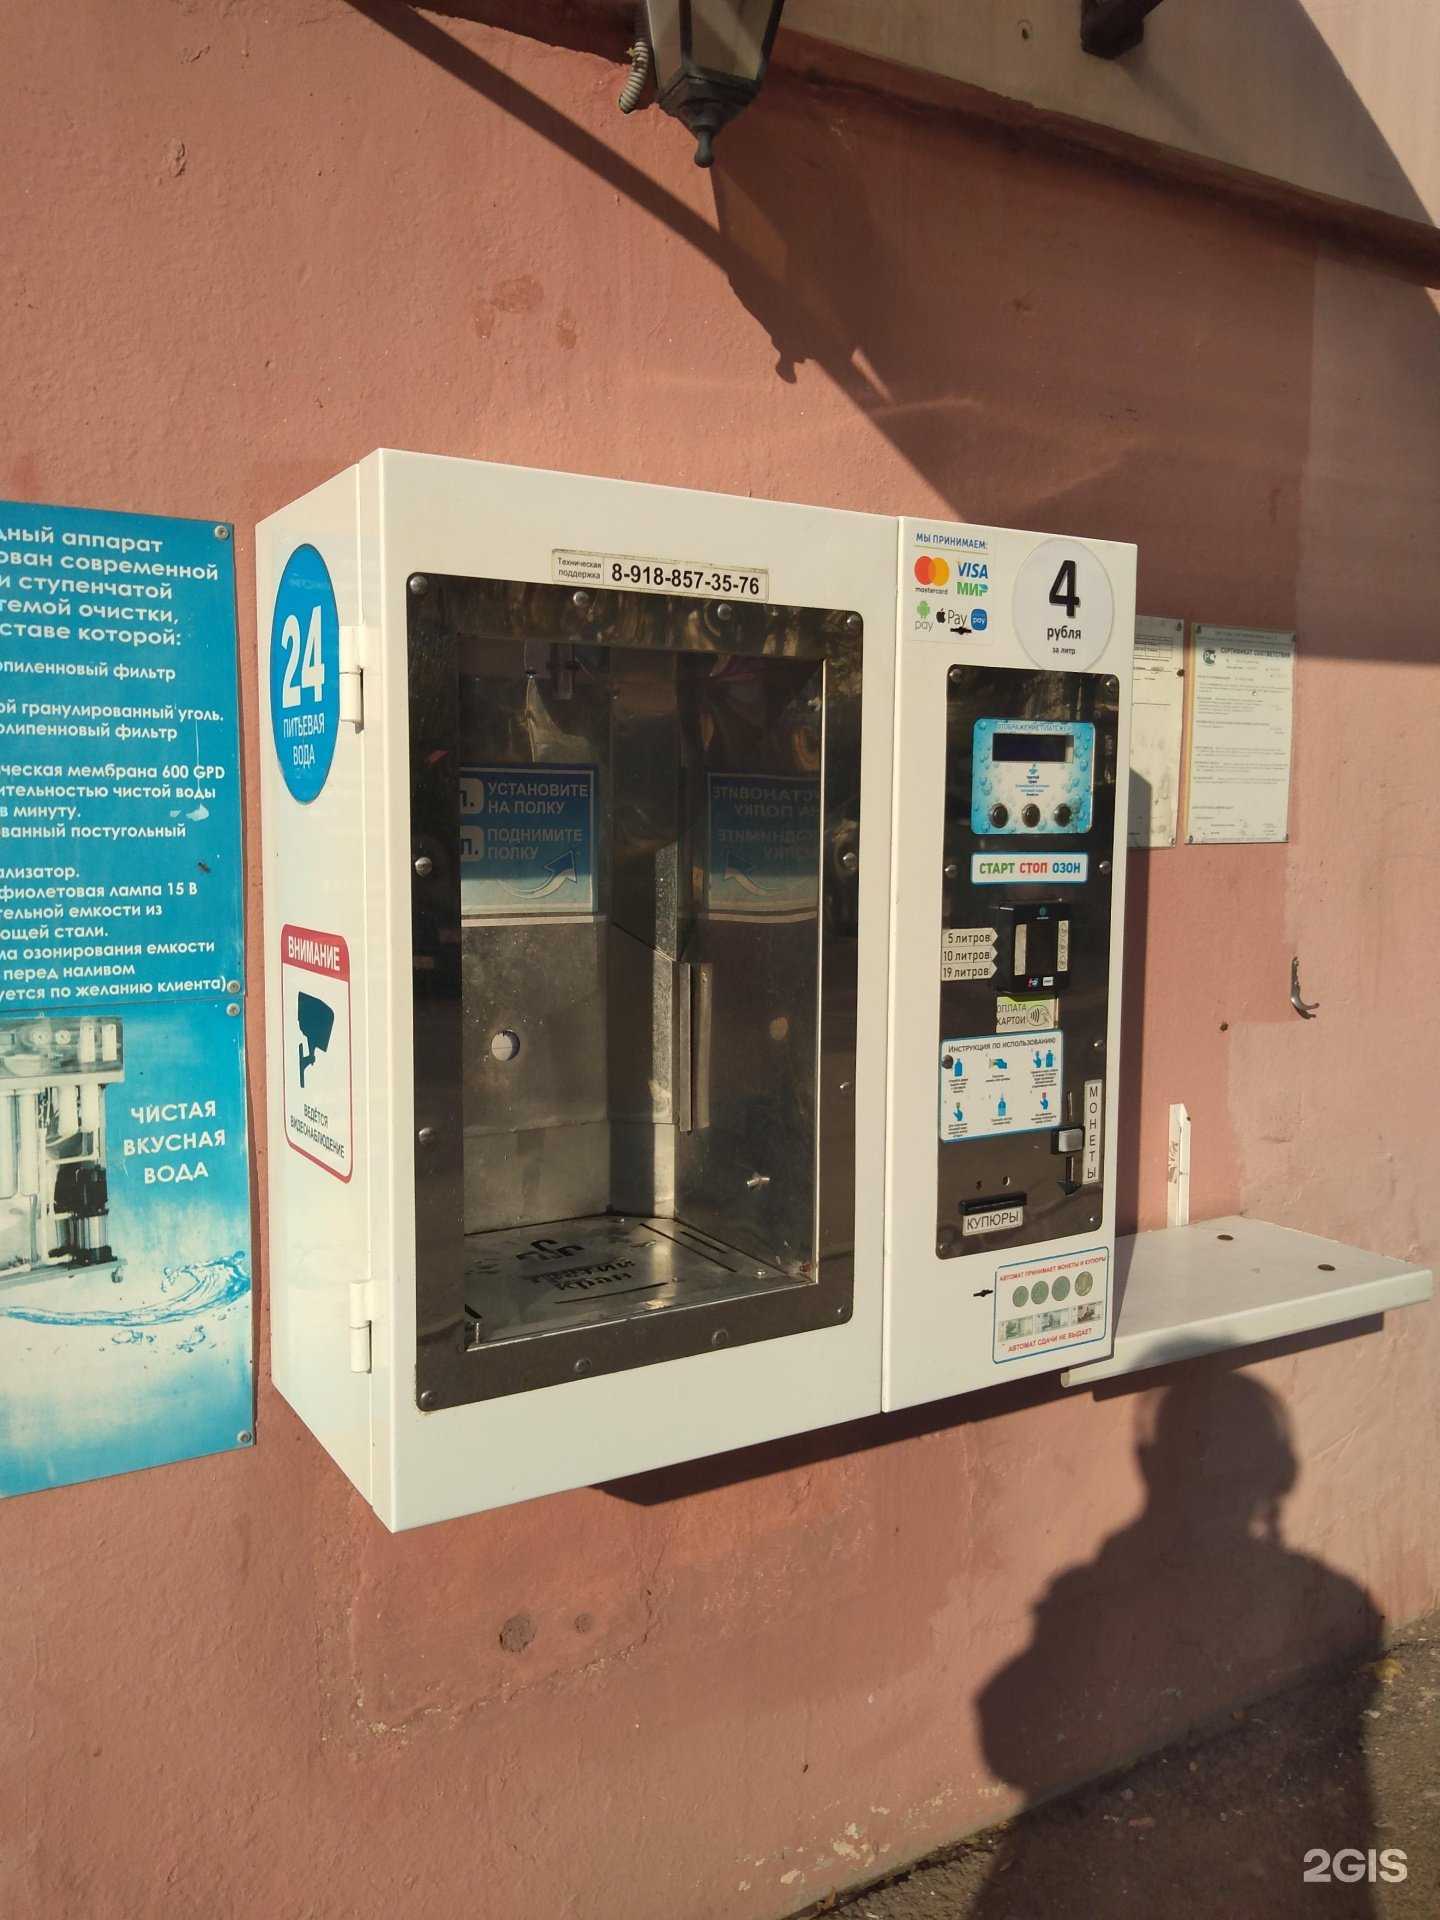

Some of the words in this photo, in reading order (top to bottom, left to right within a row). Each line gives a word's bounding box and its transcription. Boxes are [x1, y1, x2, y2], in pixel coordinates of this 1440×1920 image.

[62, 531, 164, 553] аппарат
[916, 533, 931, 543] МЫ
[60, 555, 219, 581] современной
[557, 557, 602, 569] Техническая
[957, 561, 989, 580] VISA
[558, 569, 601, 580] поддержка
[611, 563, 760, 595] 8-918-857-35-76
[19, 575, 173, 600] ступенчатой
[915, 585, 949, 596] mastercard
[956, 581, 989, 597] МИР
[1049, 559, 1081, 619] 4
[79, 603, 180, 625] очистки,
[948, 608, 968, 627] Pay
[914, 619, 935, 632] pay
[1047, 625, 1082, 641] рубля
[78, 627, 182, 647] которой:
[281, 604, 325, 709] 24
[1052, 646, 1060, 655] за
[1061, 647, 1076, 656] литр
[113, 663, 177, 683] фильтр
[22, 702, 174, 719] гранулированный
[178, 707, 225, 723] уголь.
[115, 723, 178, 742] фильтр
[283, 711, 325, 739] ПИТЬЕВАЯ
[293, 743, 316, 769] ВОДА
[68, 763, 158, 779] мембрана
[162, 765, 189, 779] 600
[193, 765, 226, 780] GPD
[113, 784, 171, 799] чистой
[176, 787, 216, 801] воды
[487, 781, 588, 798] УСТАНОВИТЕ
[13, 805, 82, 820] минуту.
[488, 799, 513, 815] НА
[515, 800, 565, 816] ПОЛКУ
[71, 823, 187, 840] постугольный
[487, 827, 584, 844] ПОДНИМИТЕ
[487, 846, 539, 861] ПОЛКУ
[979, 861, 1016, 875] СТАРТ
[1019, 861, 1048, 874] СТОП
[1052, 861, 1081, 874] ОЗОН
[109, 885, 162, 898] лампа
[167, 883, 185, 896] 15
[189, 882, 198, 896] В
[69, 903, 141, 918] емкости
[146, 903, 163, 916] из
[54, 925, 109, 939] стали.
[948, 932, 954, 944] 5
[955, 933, 991, 946] литров
[23, 943, 142, 961] озонирования
[147, 940, 215, 954] емкости
[287, 935, 341, 972] ВНИМАНИЕ
[942, 950, 953, 962] 10
[955, 951, 990, 964] литров
[3, 967, 59, 983] перед
[63, 963, 136, 977] наливом
[942, 967, 952, 978] 19
[954, 967, 989, 981] литров
[50, 986, 71, 999] по
[76, 983, 153, 997] желанию
[157, 976, 227, 993] клиента)
[131, 1099, 217, 1122] ЧИСТАЯ
[1087, 1086, 1098, 1180] МОНЕТЫ
[124, 1129, 227, 1156] ВКУСНАЯ
[144, 1164, 209, 1186] ВОДА
[966, 1210, 1019, 1231] КУПЮРЫ
[1037, 1336, 1059, 1346] СДАЧИ
[1059, 1333, 1067, 1341] НЕ
